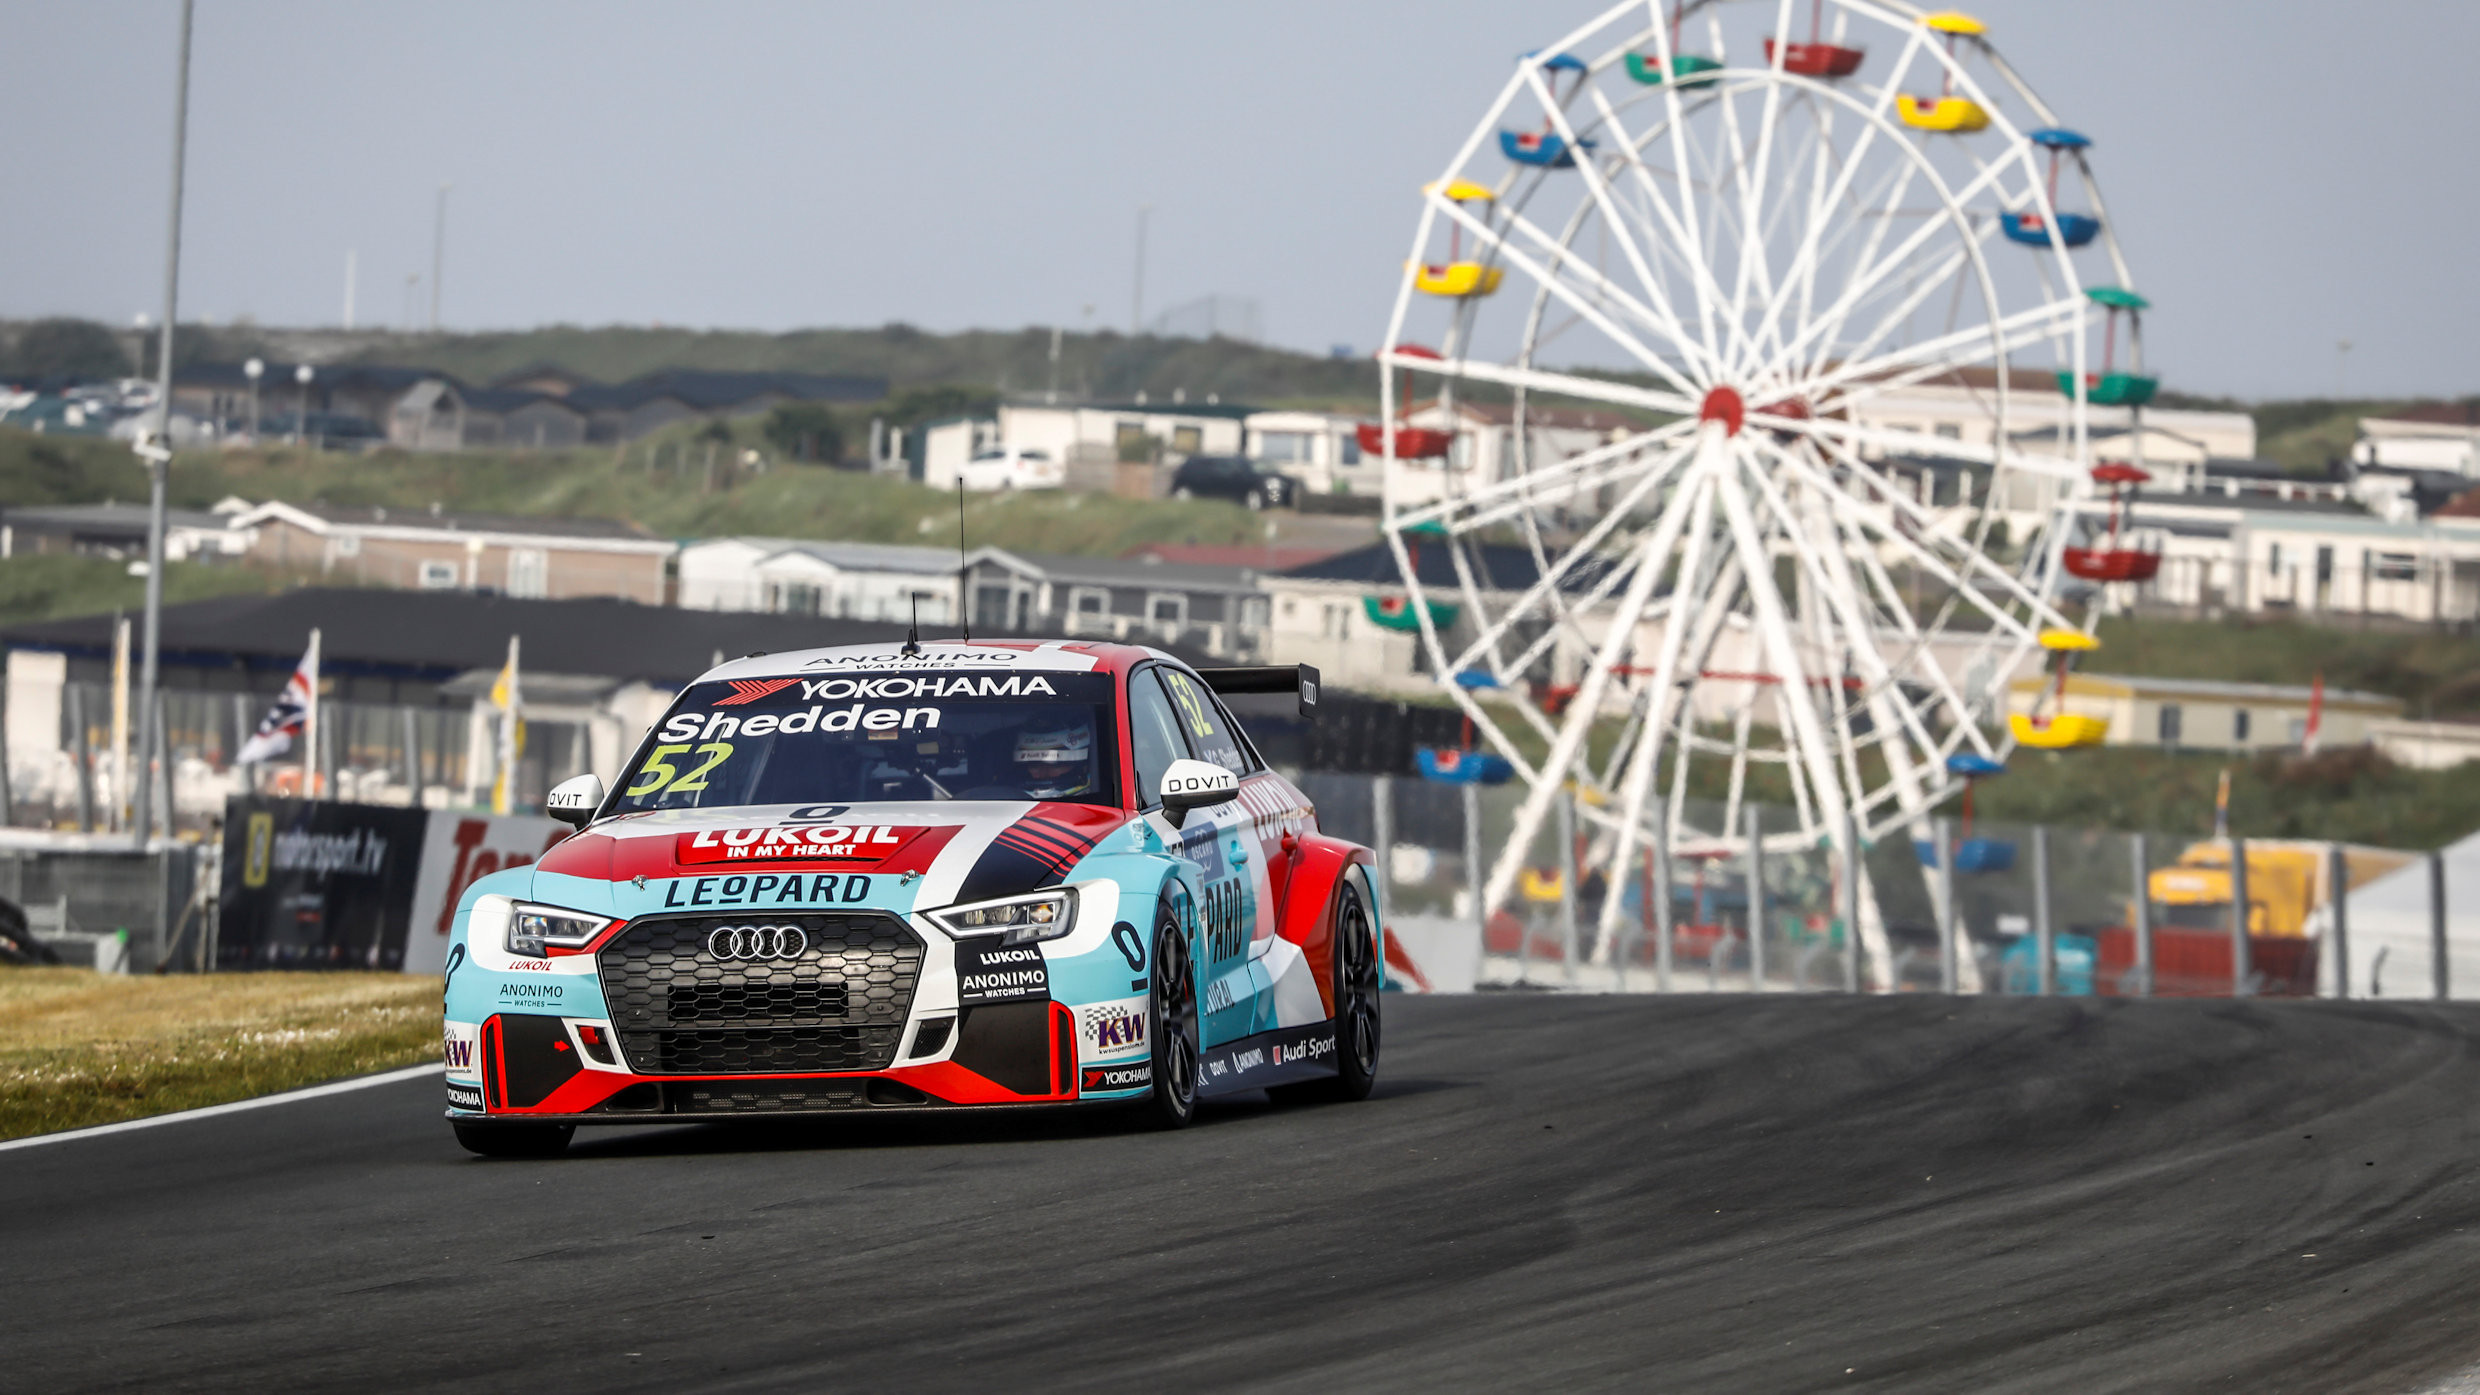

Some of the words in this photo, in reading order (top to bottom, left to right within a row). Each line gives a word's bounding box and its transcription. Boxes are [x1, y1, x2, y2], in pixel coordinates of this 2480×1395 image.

[804, 653, 1018, 667] ANONIMO
[856, 662, 955, 670] WATCHES
[800, 676, 1058, 700] YOKOHAMA
[1168, 673, 1215, 738] 52
[658, 703, 942, 743] Shedden
[626, 742, 734, 797] 52
[1169, 775, 1230, 793] DOVIT
[549, 793, 582, 806] OVIT
[692, 826, 899, 848] LUKOIL
[727, 847, 744, 858] IN
[755, 845, 783, 857] MY
[792, 844, 856, 856] HEART
[664, 874, 872, 908] LEOPARD
[508, 960, 552, 971] LUKOIL
[979, 950, 1040, 965] LUKOIL
[962, 970, 1045, 990] ANONIMO
[500, 983, 563, 998] ANONIMO
[984, 987, 1025, 999] WATCHES
[514, 1000, 545, 1008] WATCHES
[1098, 1012, 1145, 1049] KW
[1283, 1041, 1306, 1062] Audi
[1308, 1035, 1335, 1059] Sport
